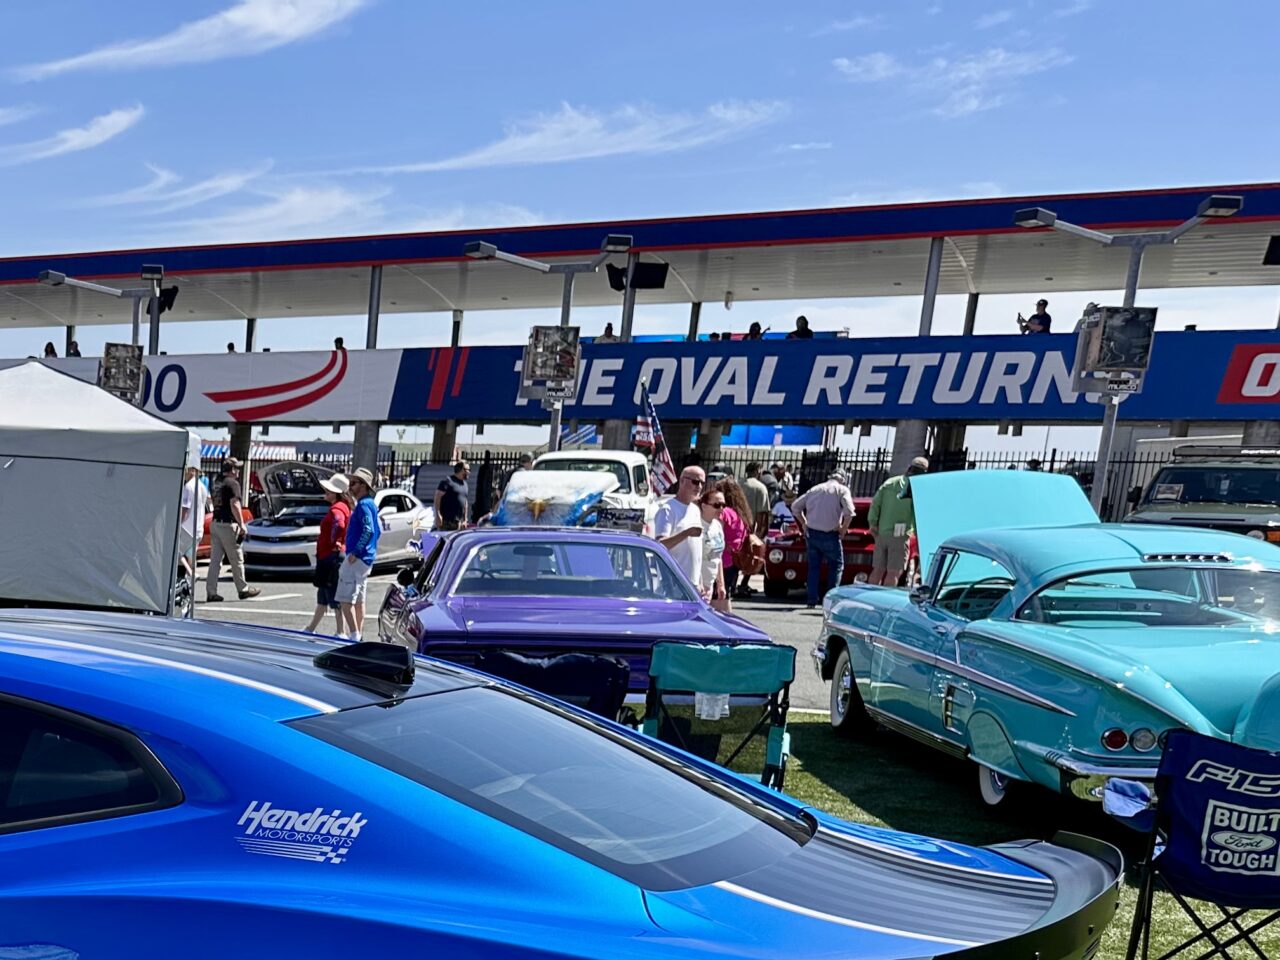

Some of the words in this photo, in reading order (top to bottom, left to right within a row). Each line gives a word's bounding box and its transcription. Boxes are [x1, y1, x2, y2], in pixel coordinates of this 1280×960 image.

[634, 357, 796, 405] OVAL
[237, 800, 368, 838] Hendrick
[1213, 807, 1280, 833] BUILT
[255, 828, 355, 847] MOTORSPORTS
[1224, 834, 1263, 848] Ford
[1208, 848, 1275, 869] TOUGH
